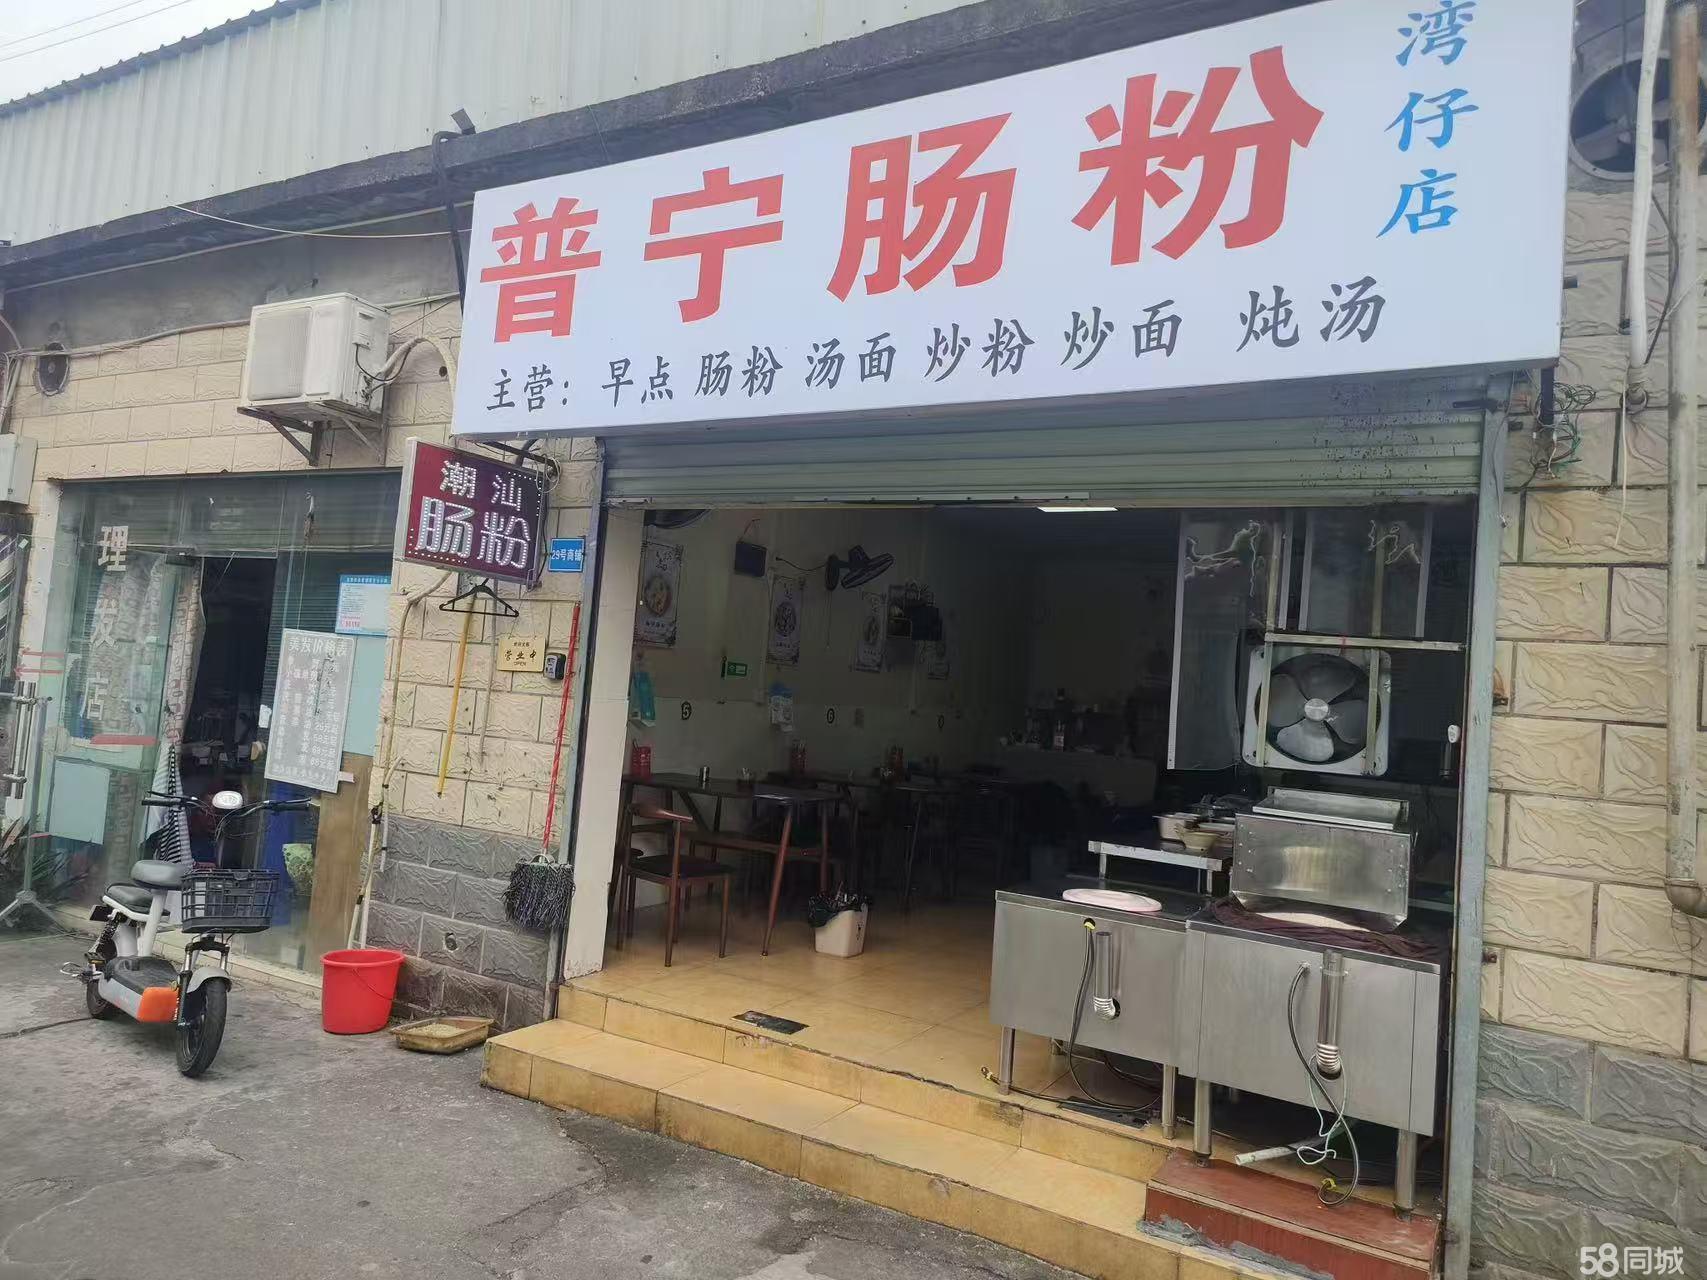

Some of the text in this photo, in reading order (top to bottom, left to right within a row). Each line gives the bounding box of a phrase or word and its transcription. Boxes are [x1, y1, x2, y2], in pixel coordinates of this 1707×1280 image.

[1376, 1, 1479, 238] 湾仔店
[480, 45, 1324, 343] 普宁肠粉
[601, 355, 674, 407] 早点
[695, 345, 784, 399] 肠粉
[805, 331, 897, 389] 汤面
[923, 318, 1035, 382] 炒粉
[1060, 299, 1183, 370] 炒面
[1236, 275, 1387, 352] 炖汤
[414, 495, 531, 568] 肠粉
[440, 459, 523, 512] 潮汕
[551, 549, 583, 562] 29号商铺
[80, 525, 128, 721] 理发店
[504, 648, 537, 662] 营业中
